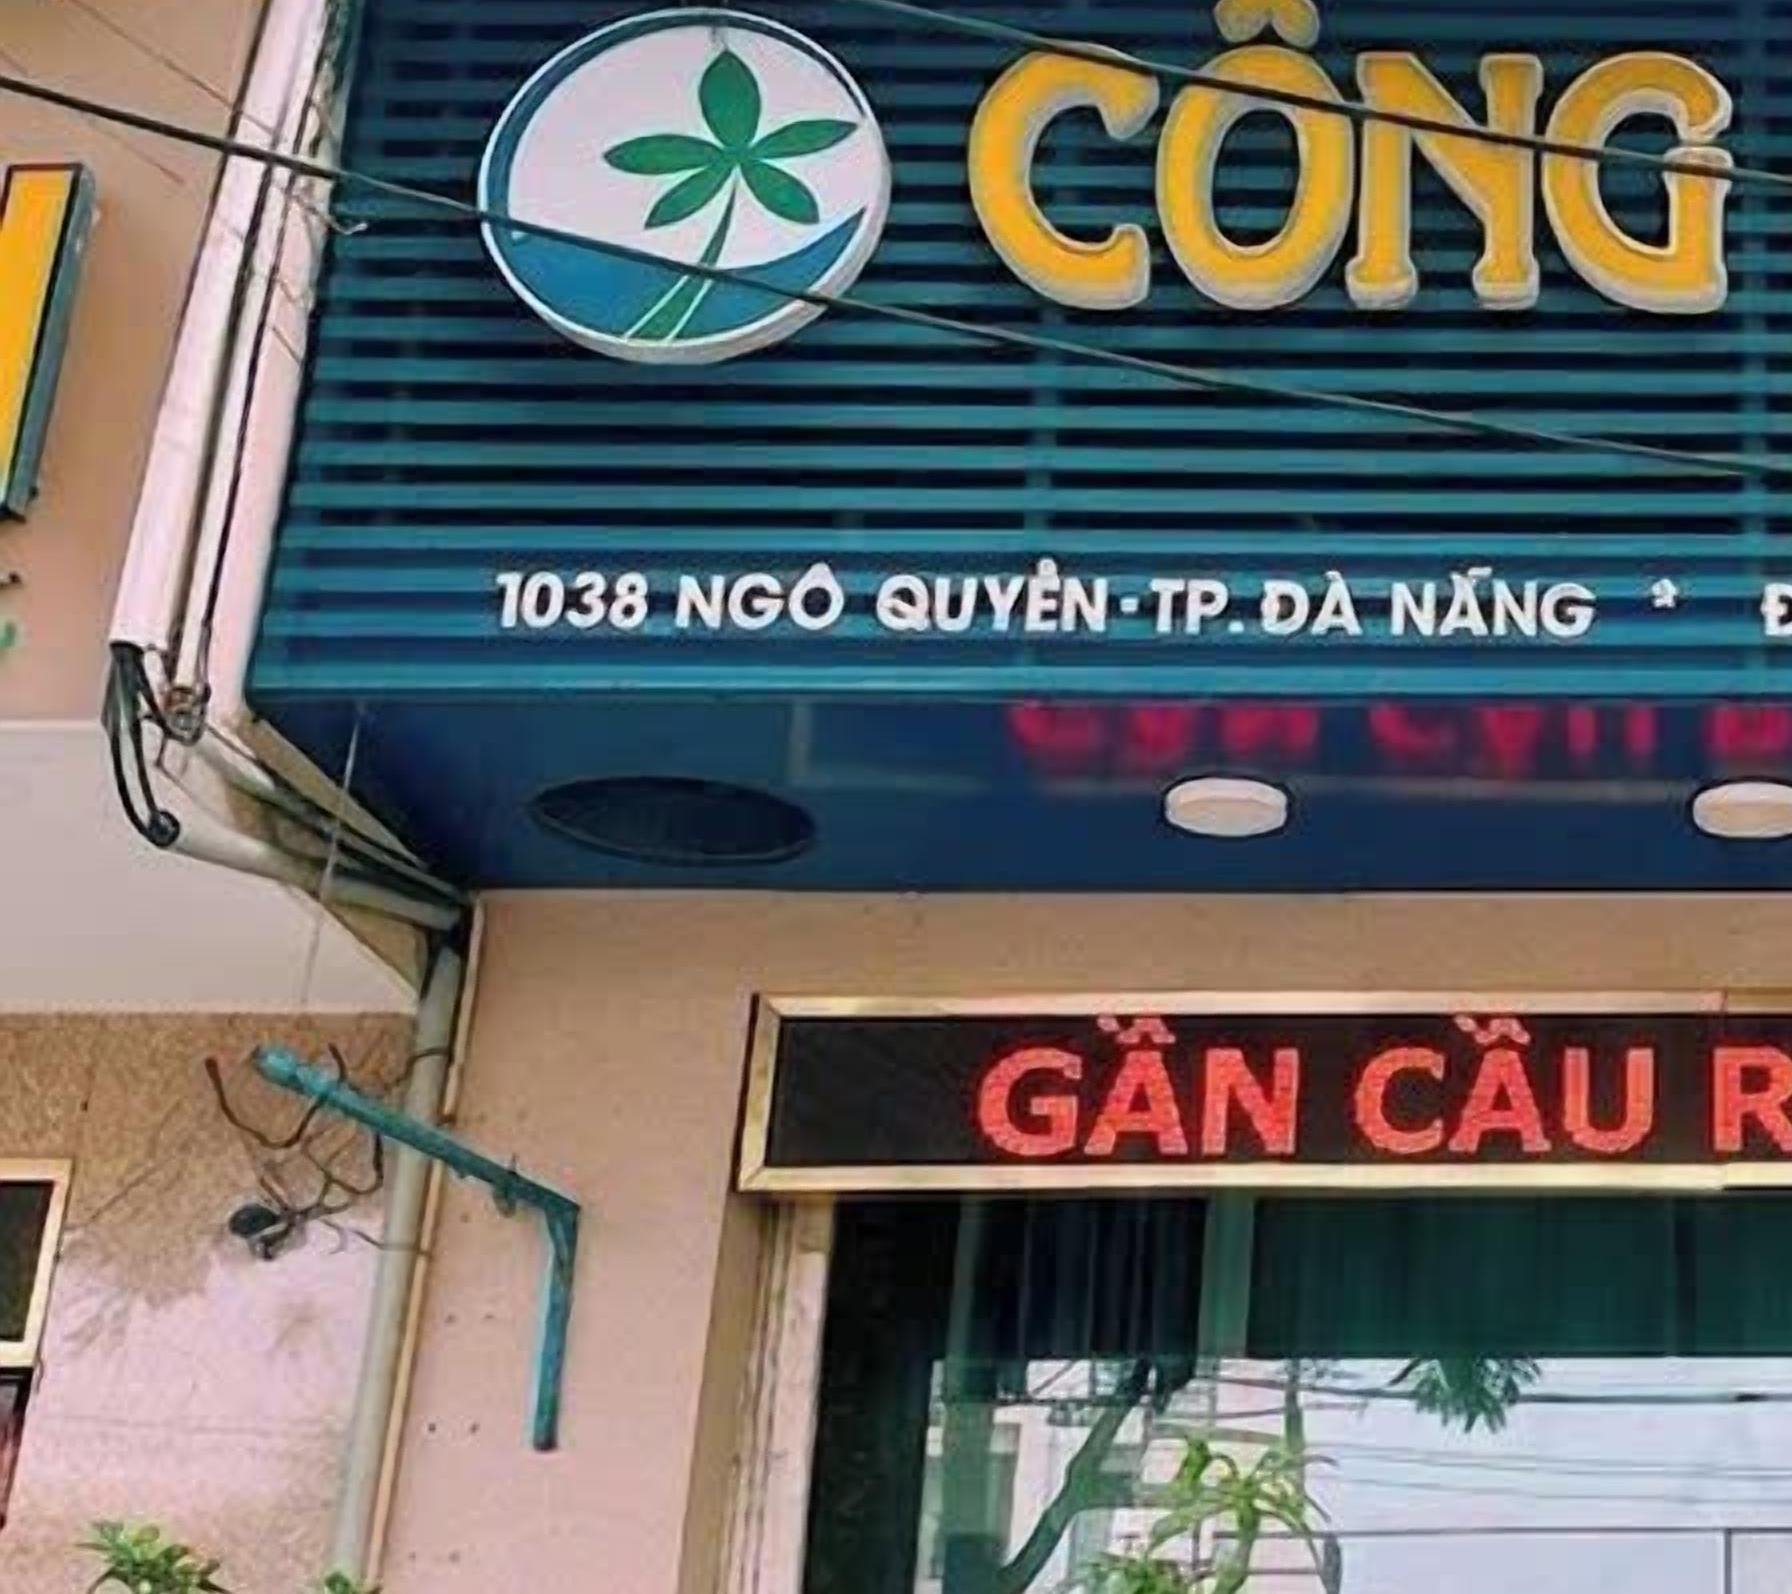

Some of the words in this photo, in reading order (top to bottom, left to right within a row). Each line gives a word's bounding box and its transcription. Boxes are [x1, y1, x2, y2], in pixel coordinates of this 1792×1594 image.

[496, 571, 649, 629] 1038
[676, 561, 846, 631] NGÔ
[978, 1009, 1300, 1157] GẦN
[1354, 1009, 1656, 1157] CẦU
